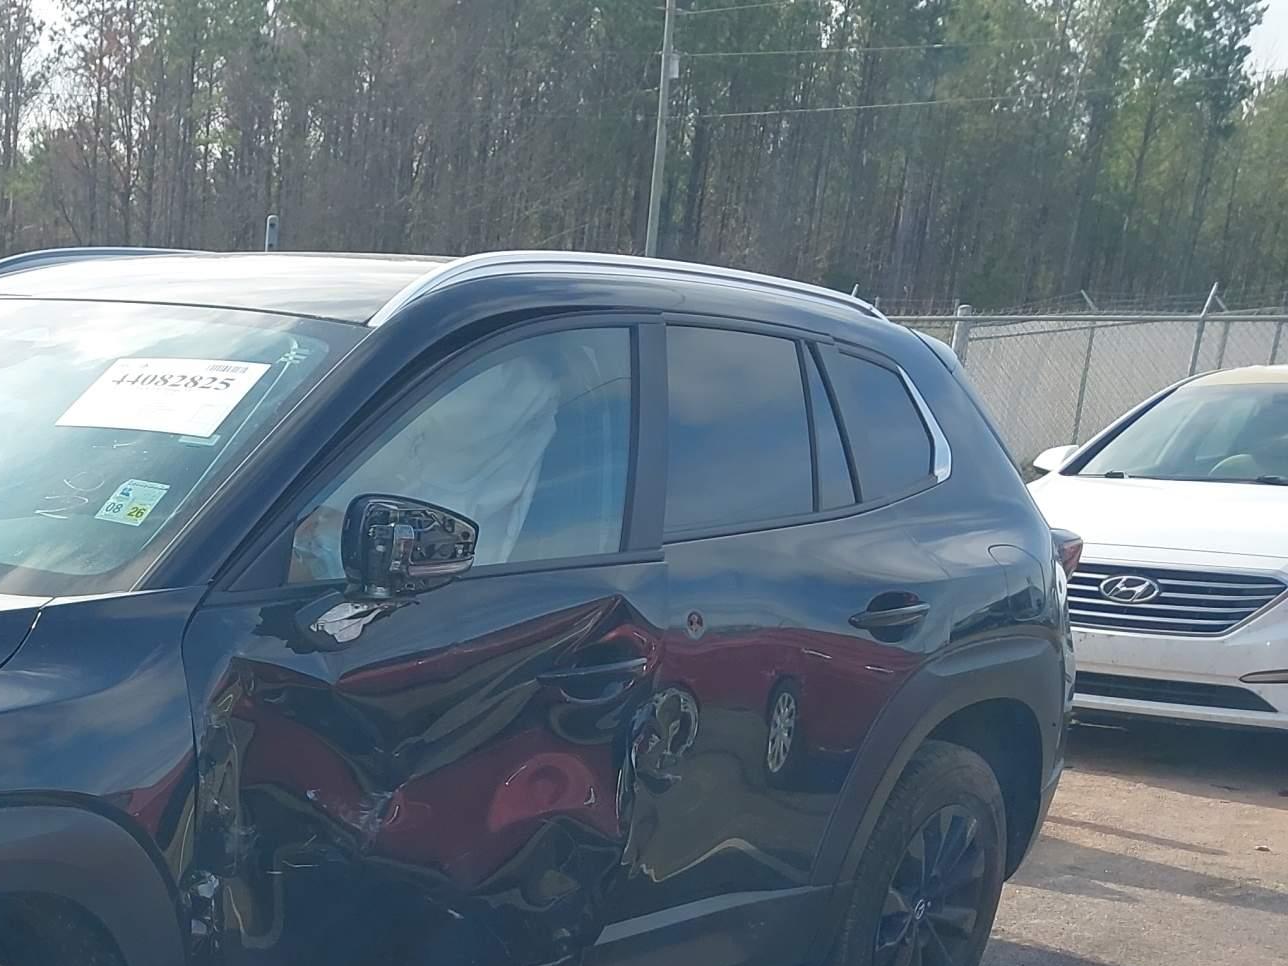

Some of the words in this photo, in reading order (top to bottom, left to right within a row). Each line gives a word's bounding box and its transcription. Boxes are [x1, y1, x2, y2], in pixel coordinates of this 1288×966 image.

[112, 373, 237, 391] 44082825
[105, 502, 123, 514] 08
[127, 506, 147, 519] 26
